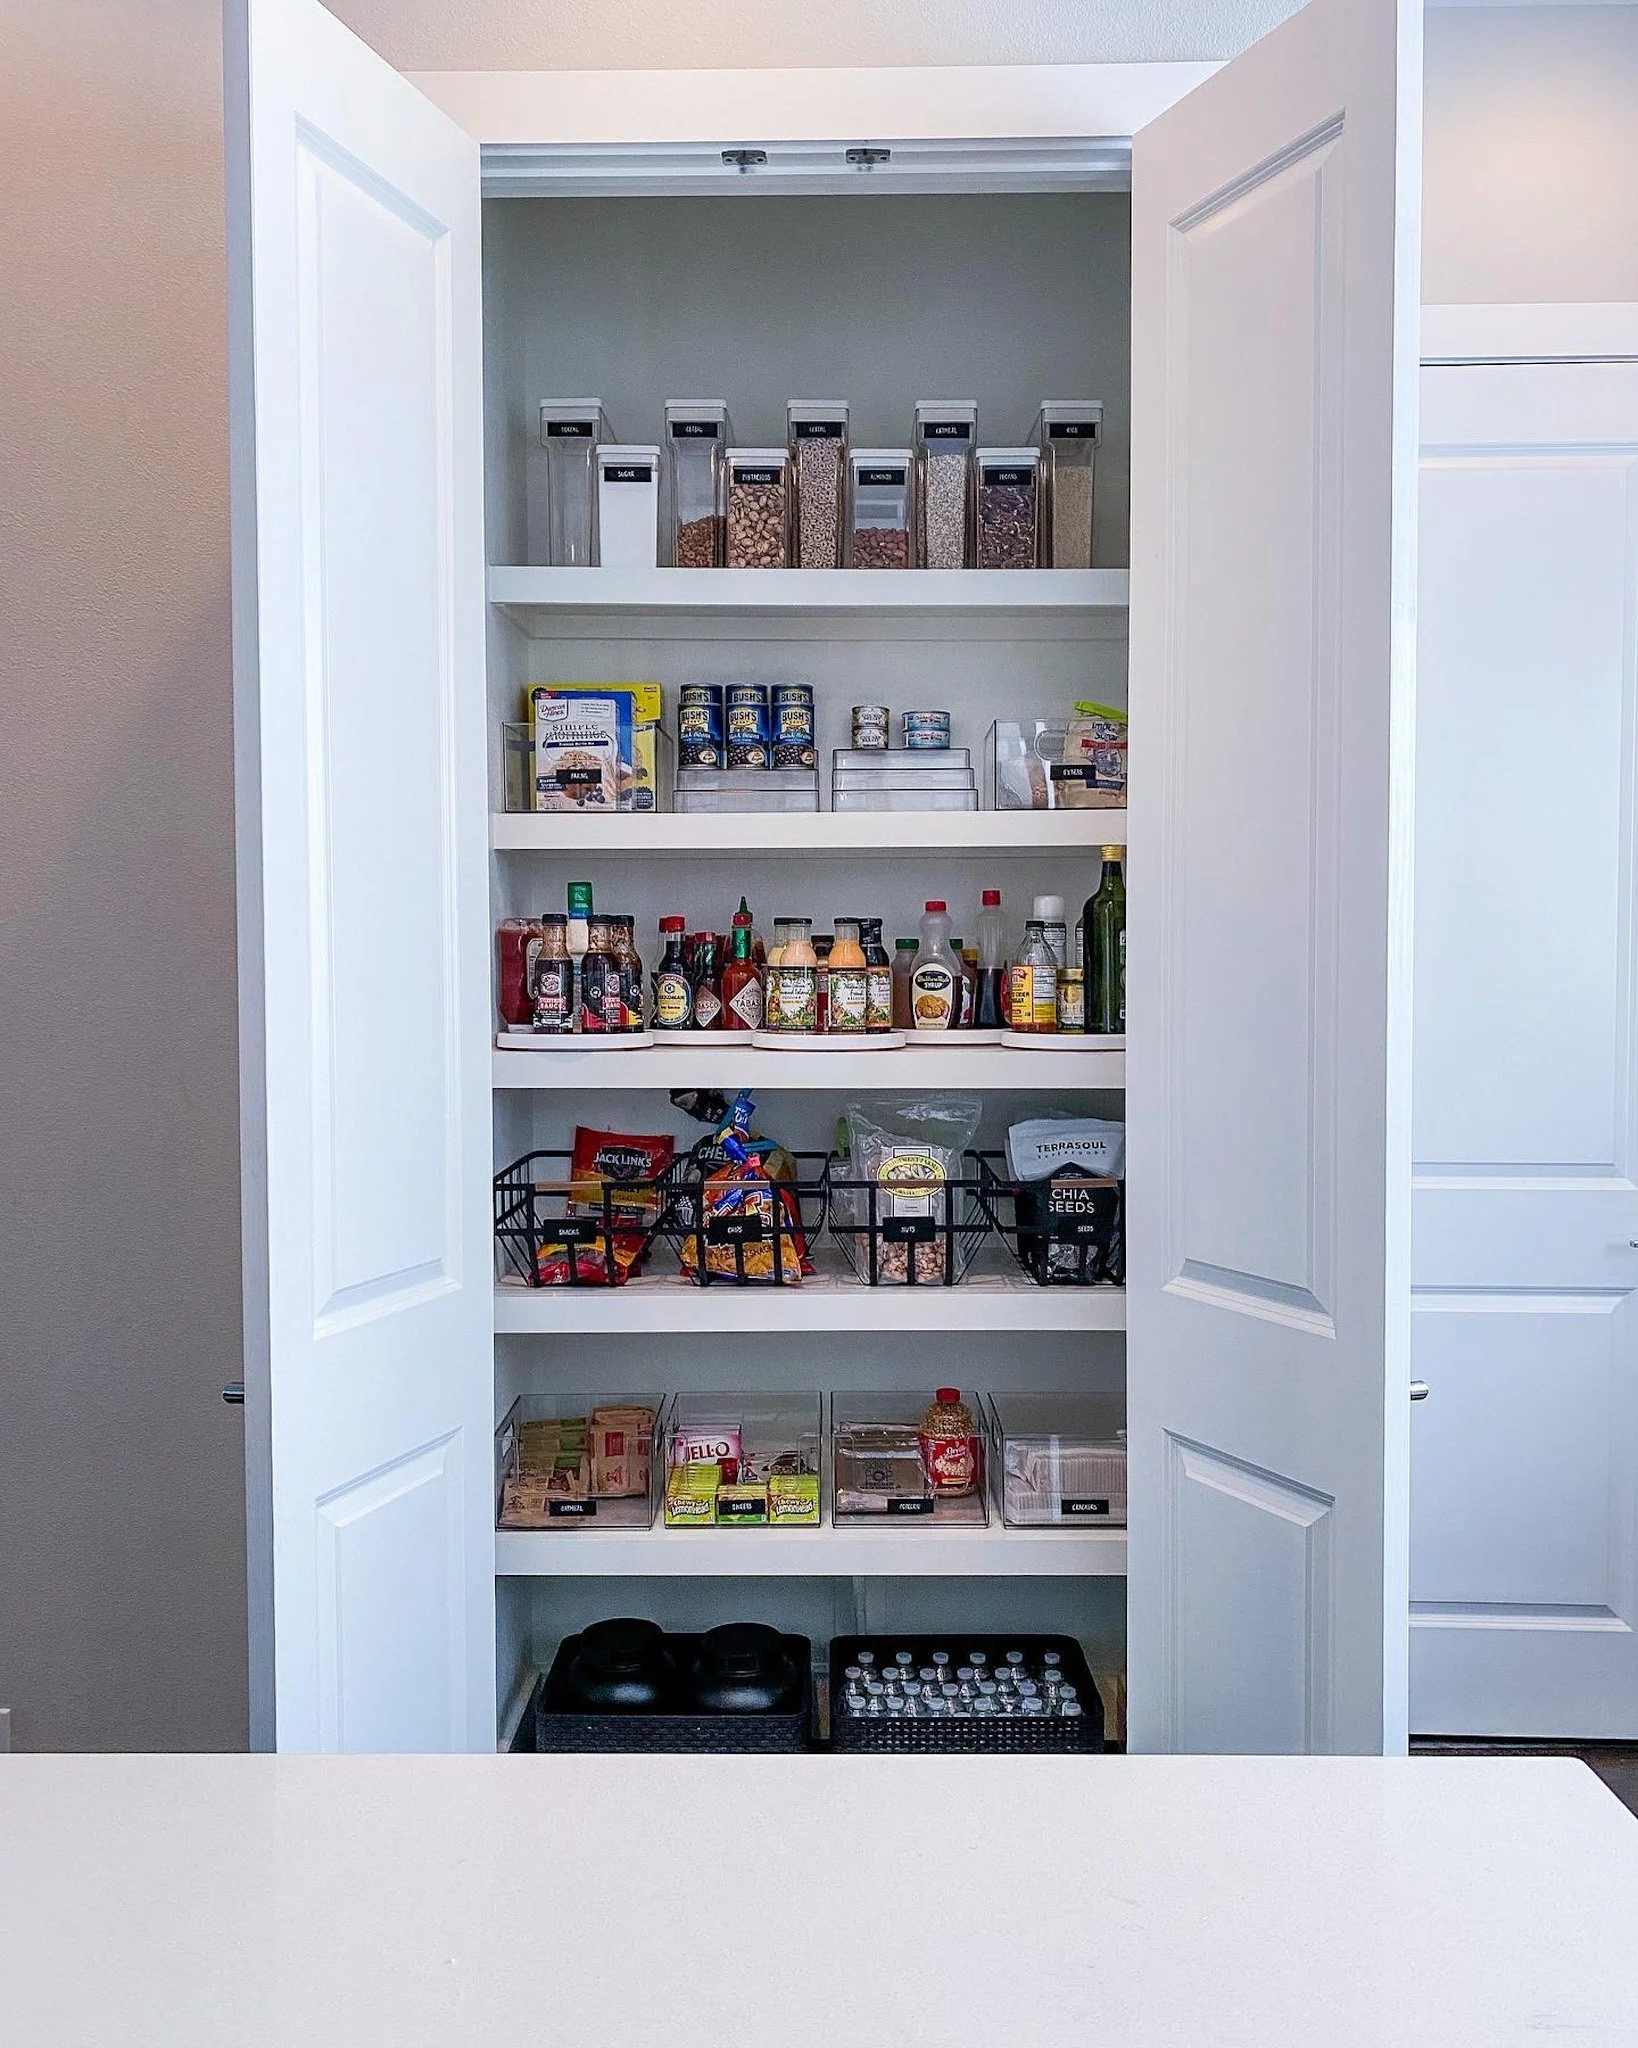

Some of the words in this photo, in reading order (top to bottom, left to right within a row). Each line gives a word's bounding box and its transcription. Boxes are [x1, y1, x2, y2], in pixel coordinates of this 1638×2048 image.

[923, 981, 943, 989] SYRUP
[1035, 1141, 1108, 1154] TERRASOUL
[593, 1151, 620, 1165] JACK
[1051, 1188, 1090, 1200] CHIA
[1048, 1200, 1096, 1214] SEEDS
[560, 1504, 585, 1512] OATMEAL
